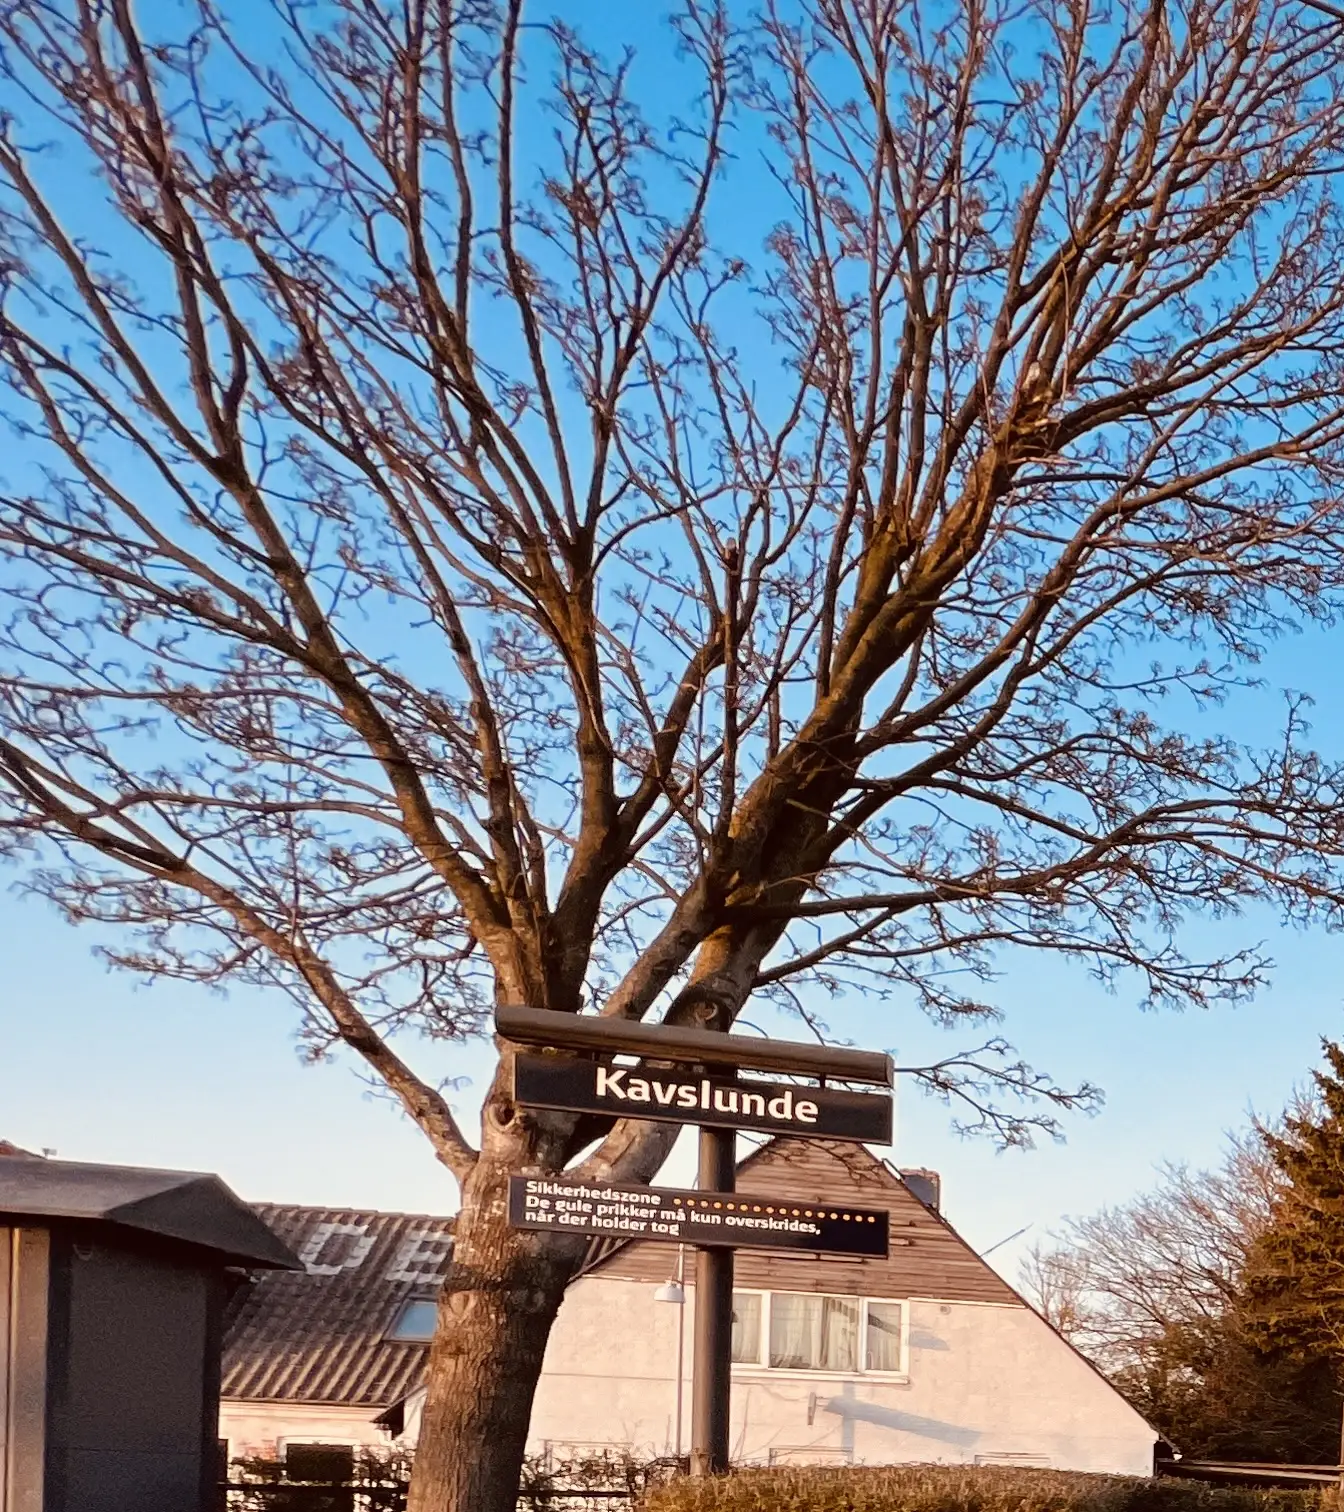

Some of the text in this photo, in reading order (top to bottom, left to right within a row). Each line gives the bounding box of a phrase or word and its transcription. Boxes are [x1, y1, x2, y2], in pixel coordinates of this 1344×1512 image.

[595, 1066, 820, 1124] Kavslunde
[526, 1180, 661, 1205] Sikkerhedszone
[525, 1195, 821, 1235] De gule prikker må kun overskrides,
[525, 1209, 680, 1237] når der holder tog
